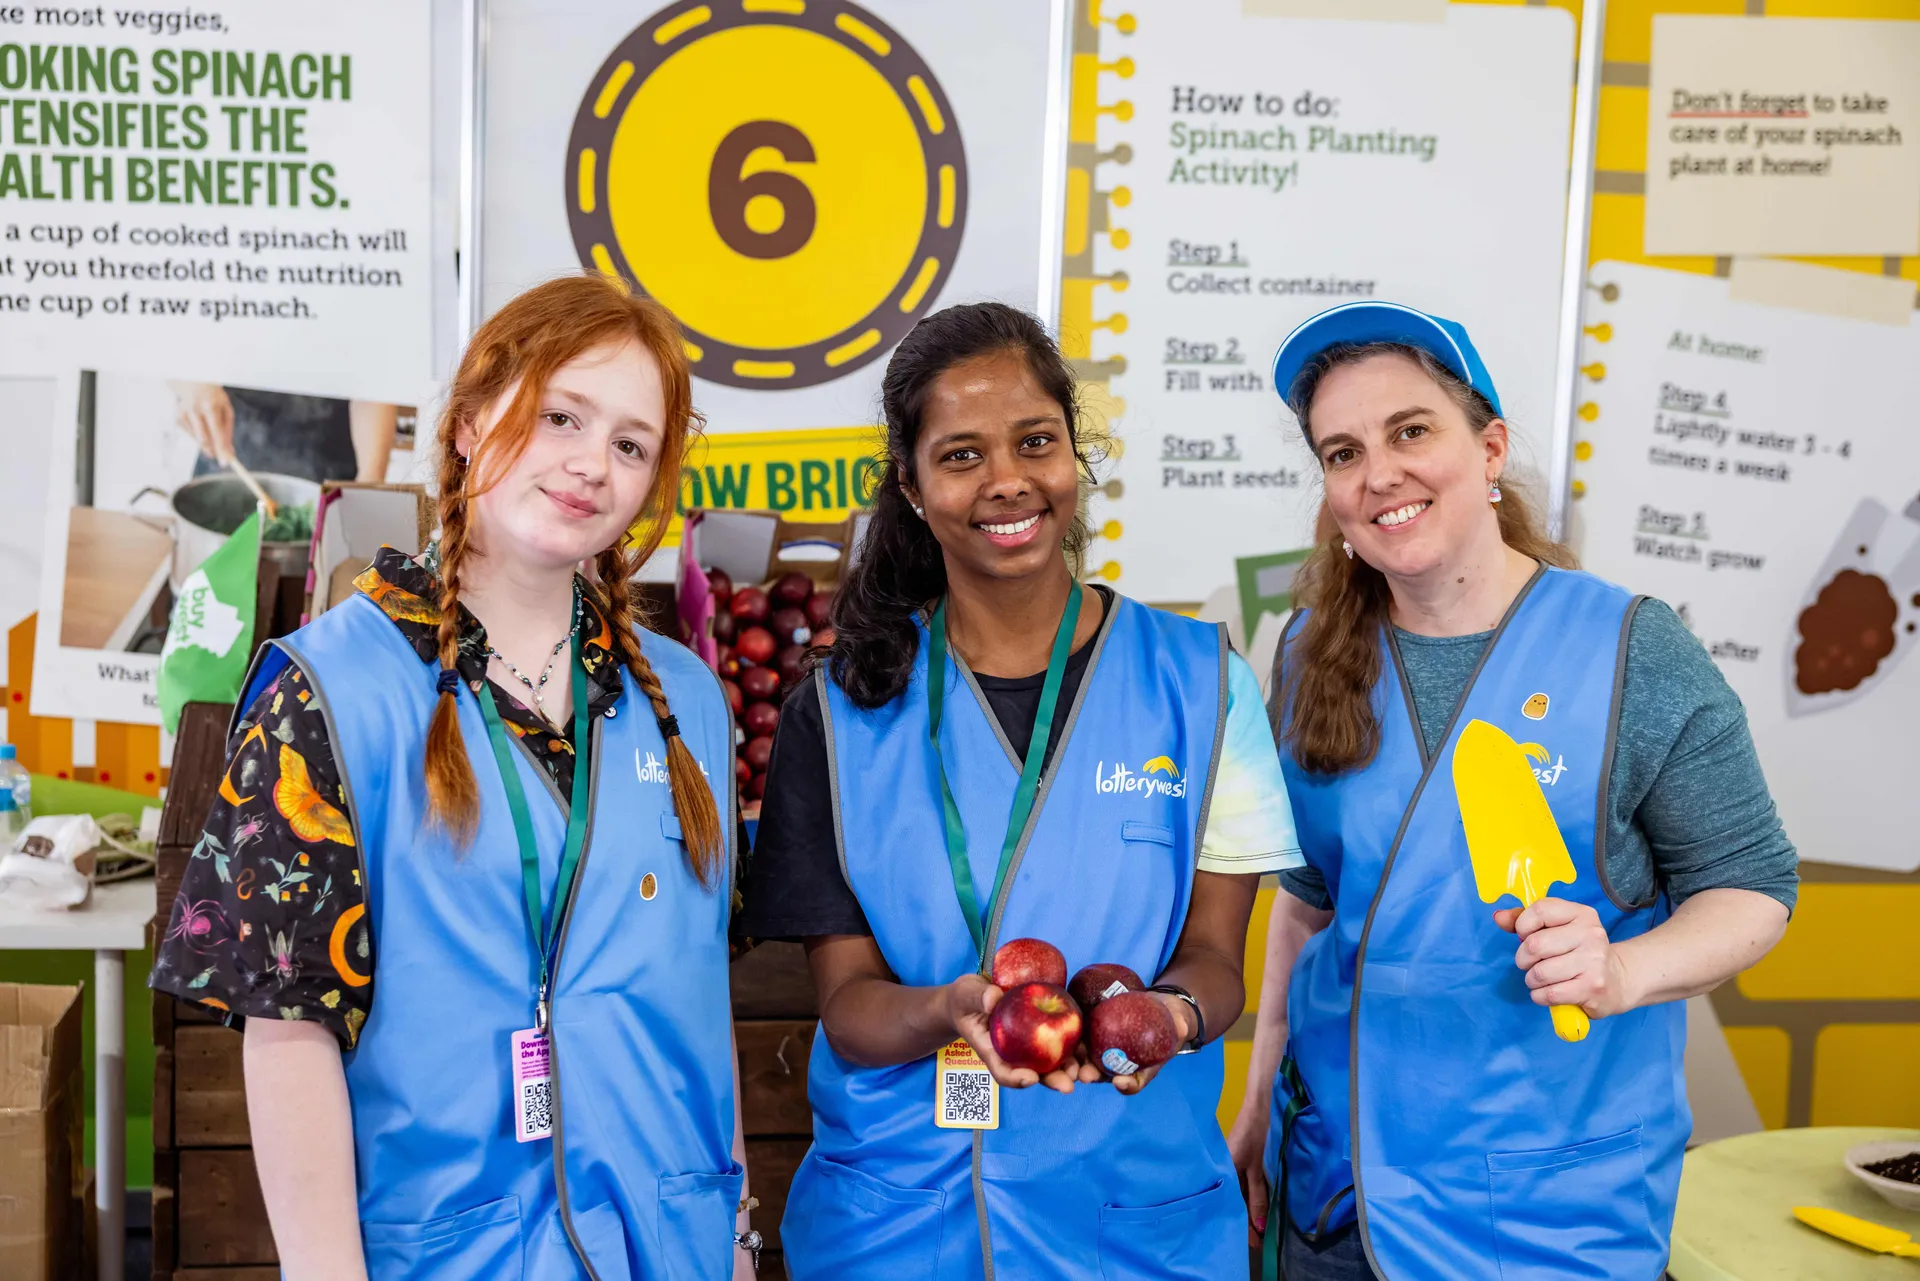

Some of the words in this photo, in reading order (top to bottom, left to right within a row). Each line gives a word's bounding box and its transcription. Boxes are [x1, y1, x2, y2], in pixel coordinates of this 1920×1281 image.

[35, 6, 104, 27] most
[114, 7, 229, 35] veggies,
[152, 49, 351, 100] SPINACH
[1170, 86, 1243, 115] How
[1254, 90, 1284, 116] to
[1294, 90, 1339, 118] do:
[1672, 88, 1732, 112] Don't
[1739, 90, 1807, 116] forget
[1813, 93, 1836, 113] to
[1841, 92, 1889, 114] take
[221, 106, 307, 153] THE
[1169, 122, 1296, 154] Spinach
[1307, 126, 1437, 162] Planting
[1669, 125, 1719, 144] care
[1724, 124, 1749, 144] of
[1754, 127, 1806, 148] your
[1814, 125, 1903, 149] spinach
[1168, 159, 1298, 193] Activity!
[1669, 154, 1728, 179] plant
[1734, 155, 1754, 176] at
[1760, 155, 1832, 177] home!
[127, 158, 350, 209] BENEFITS.
[708, 119, 817, 260] 6
[6, 224, 20, 241] a
[30, 224, 83, 248] cup
[93, 222, 120, 244] of
[129, 225, 229, 248] cooked
[239, 229, 349, 252] spinach
[358, 230, 408, 252] will
[1168, 239, 1221, 265] Step
[25, 260, 77, 283] you
[88, 257, 214, 282] threefold
[225, 260, 268, 283] the
[278, 262, 402, 286] nutrition
[1167, 273, 1252, 295] Collect
[1259, 275, 1376, 296] container
[40, 295, 93, 319] cup
[102, 293, 130, 314] of
[140, 296, 188, 315] raw
[200, 296, 317, 321] spinach.
[1165, 338, 1219, 364] Step
[1667, 330, 1692, 351] At
[1165, 370, 1200, 391] Fill
[1208, 371, 1263, 391] with
[1659, 382, 1708, 412] Step
[1162, 434, 1216, 461] Step
[1736, 429, 1797, 452] water
[1162, 467, 1224, 488] Plant
[1233, 467, 1299, 488] seeds
[1734, 460, 1791, 483] week
[1637, 505, 1688, 533] Step
[1634, 535, 1702, 564] Watch
[1709, 548, 1765, 571] grow
[188, 587, 209, 628] buy
[1096, 760, 1187, 799] lotterywest
[522, 1050, 534, 1058] the
[945, 1048, 972, 1057] Asked
